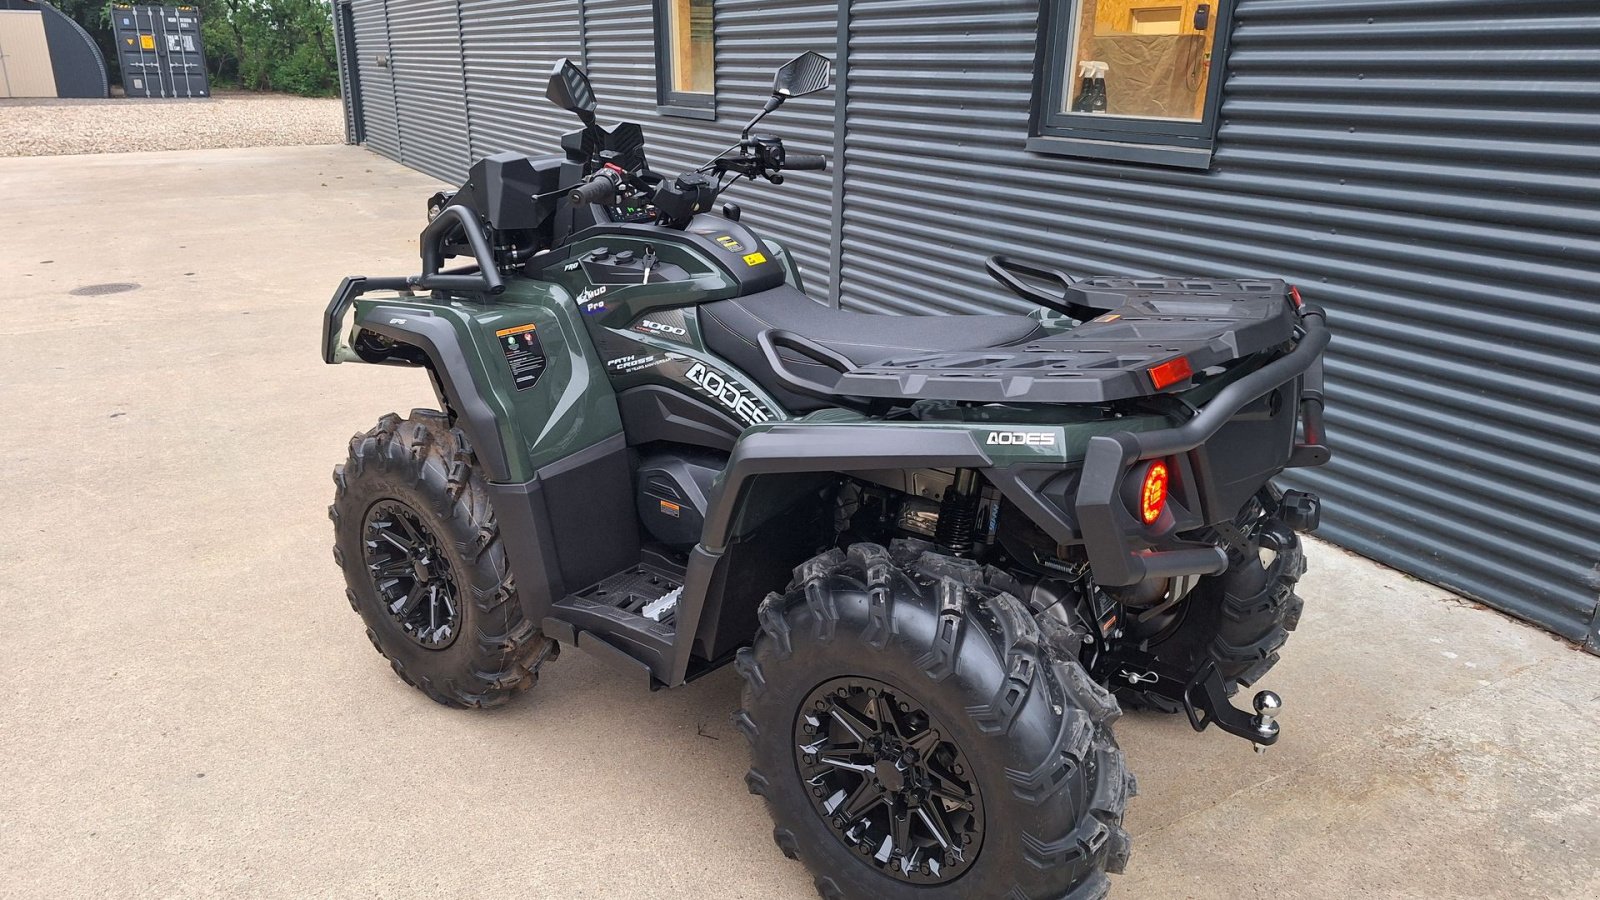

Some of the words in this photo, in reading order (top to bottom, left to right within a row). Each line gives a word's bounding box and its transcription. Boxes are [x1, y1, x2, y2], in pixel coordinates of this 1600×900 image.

[586, 285, 607, 300] MUD
[587, 301, 605, 312] Pro
[642, 320, 686, 336] 1000
[607, 355, 635, 366] PATH
[616, 355, 654, 370] CROSS
[685, 362, 769, 426] AODES
[986, 431, 1056, 446] AODES
